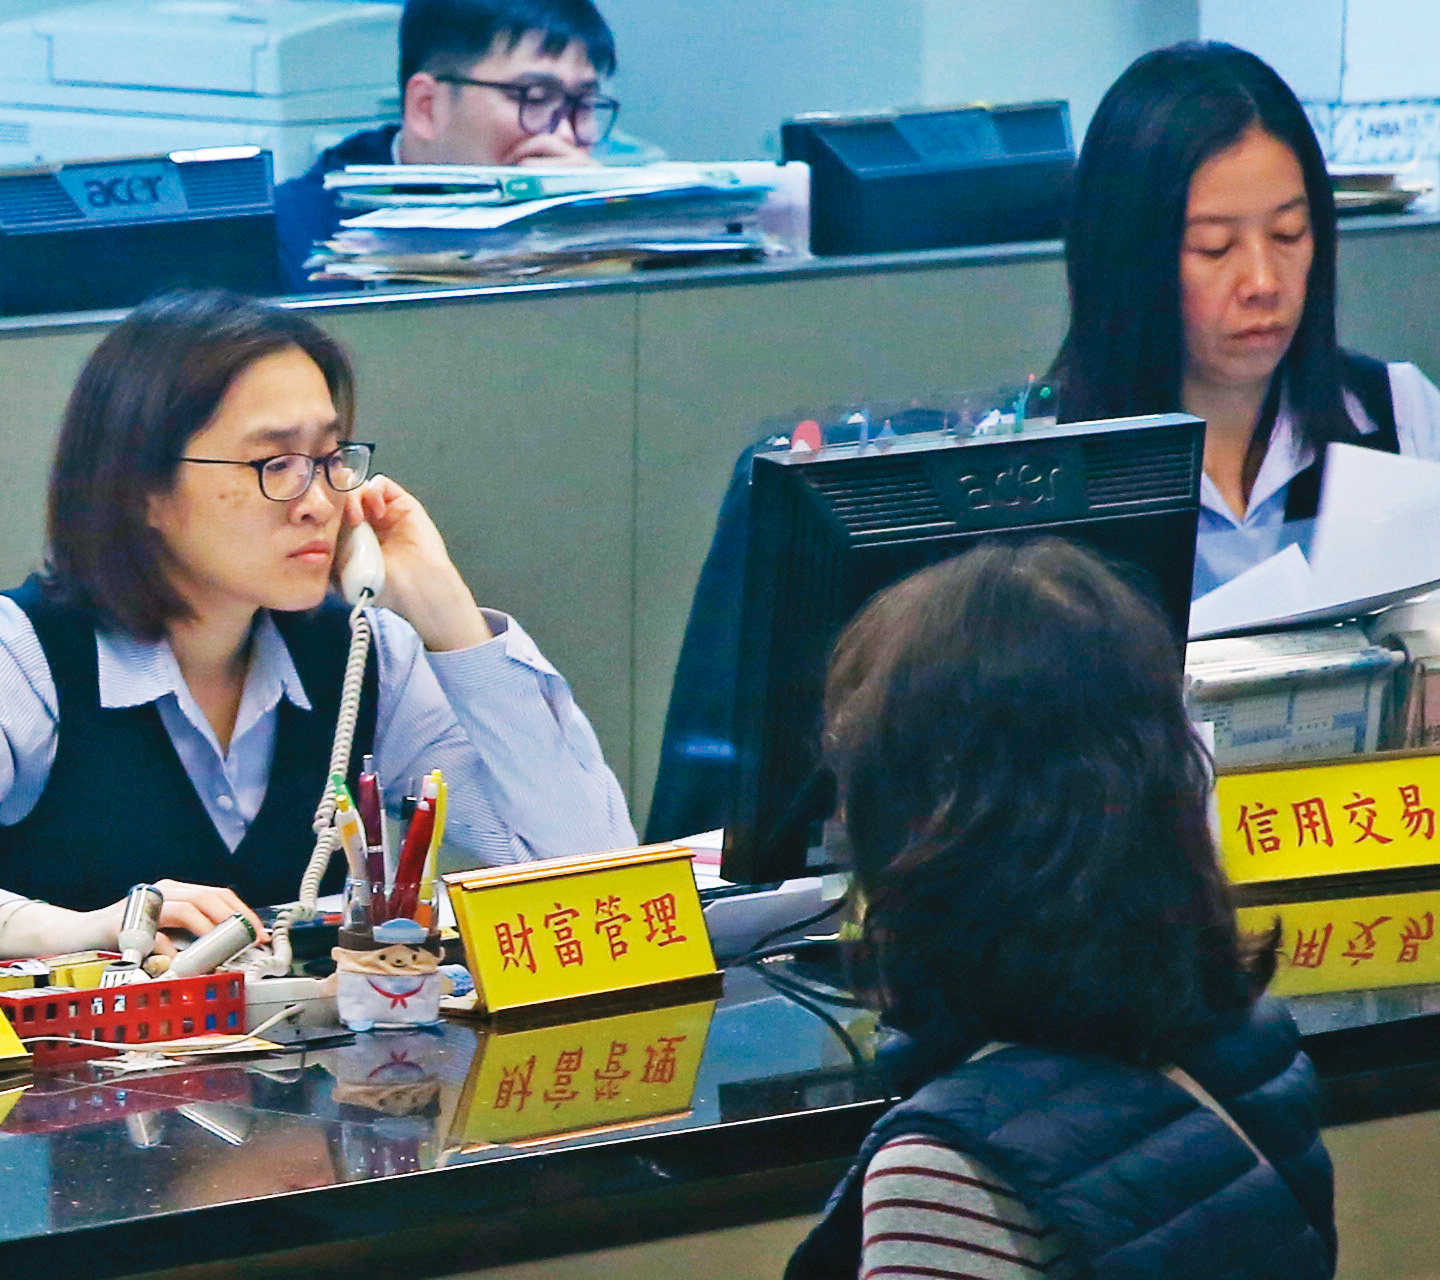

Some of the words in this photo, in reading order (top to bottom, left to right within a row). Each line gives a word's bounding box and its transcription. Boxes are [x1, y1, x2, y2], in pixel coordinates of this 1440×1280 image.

[86, 173, 167, 206] acer
[1235, 781, 1438, 859] 信用交易
[493, 892, 688, 974] 財富管理
